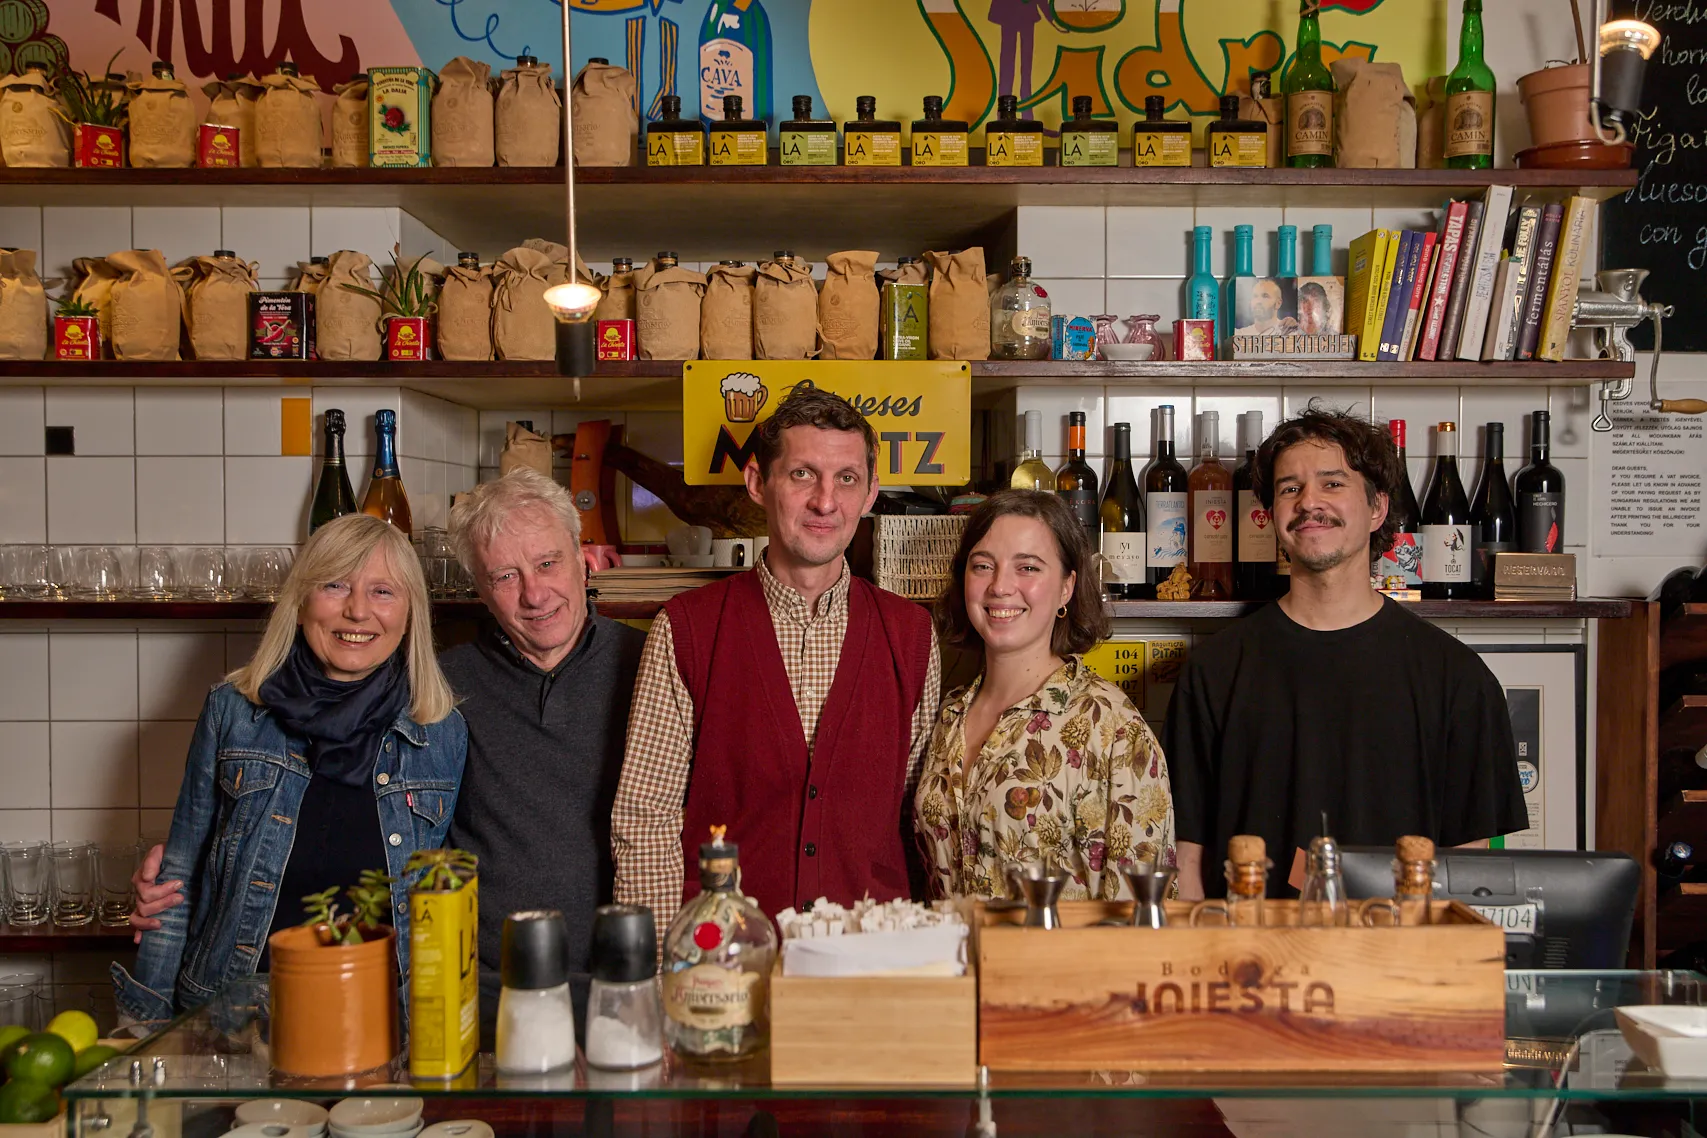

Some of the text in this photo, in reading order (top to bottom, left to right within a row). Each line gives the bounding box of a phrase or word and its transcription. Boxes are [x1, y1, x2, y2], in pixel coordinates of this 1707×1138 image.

[701, 66, 742, 86] CAVA
[649, 142, 667, 156] LA
[712, 142, 731, 156] LA
[783, 142, 801, 156] LA
[848, 142, 866, 156] LA
[915, 142, 933, 156] LA
[990, 142, 1008, 156] LA
[1064, 143, 1082, 156] LA
[1138, 143, 1156, 156] LA
[1214, 142, 1232, 156] LA
[1442, 212, 1464, 253] TAPAS
[1640, 224, 1682, 244] con
[1417, 262, 1426, 283] DINING
[1422, 243, 1431, 262] GUIDE
[1527, 239, 1553, 326] fermentálás
[1554, 268, 1574, 322] SPANYOL
[893, 302, 919, 323] LA
[1233, 335, 1358, 354] STREET KITCHEN
[1445, 564, 1462, 573] TOCAT
[1115, 649, 1138, 660] 104
[1115, 664, 1138, 674] 105
[414, 908, 434, 923] LA
[1161, 960, 1310, 977] Bodga
